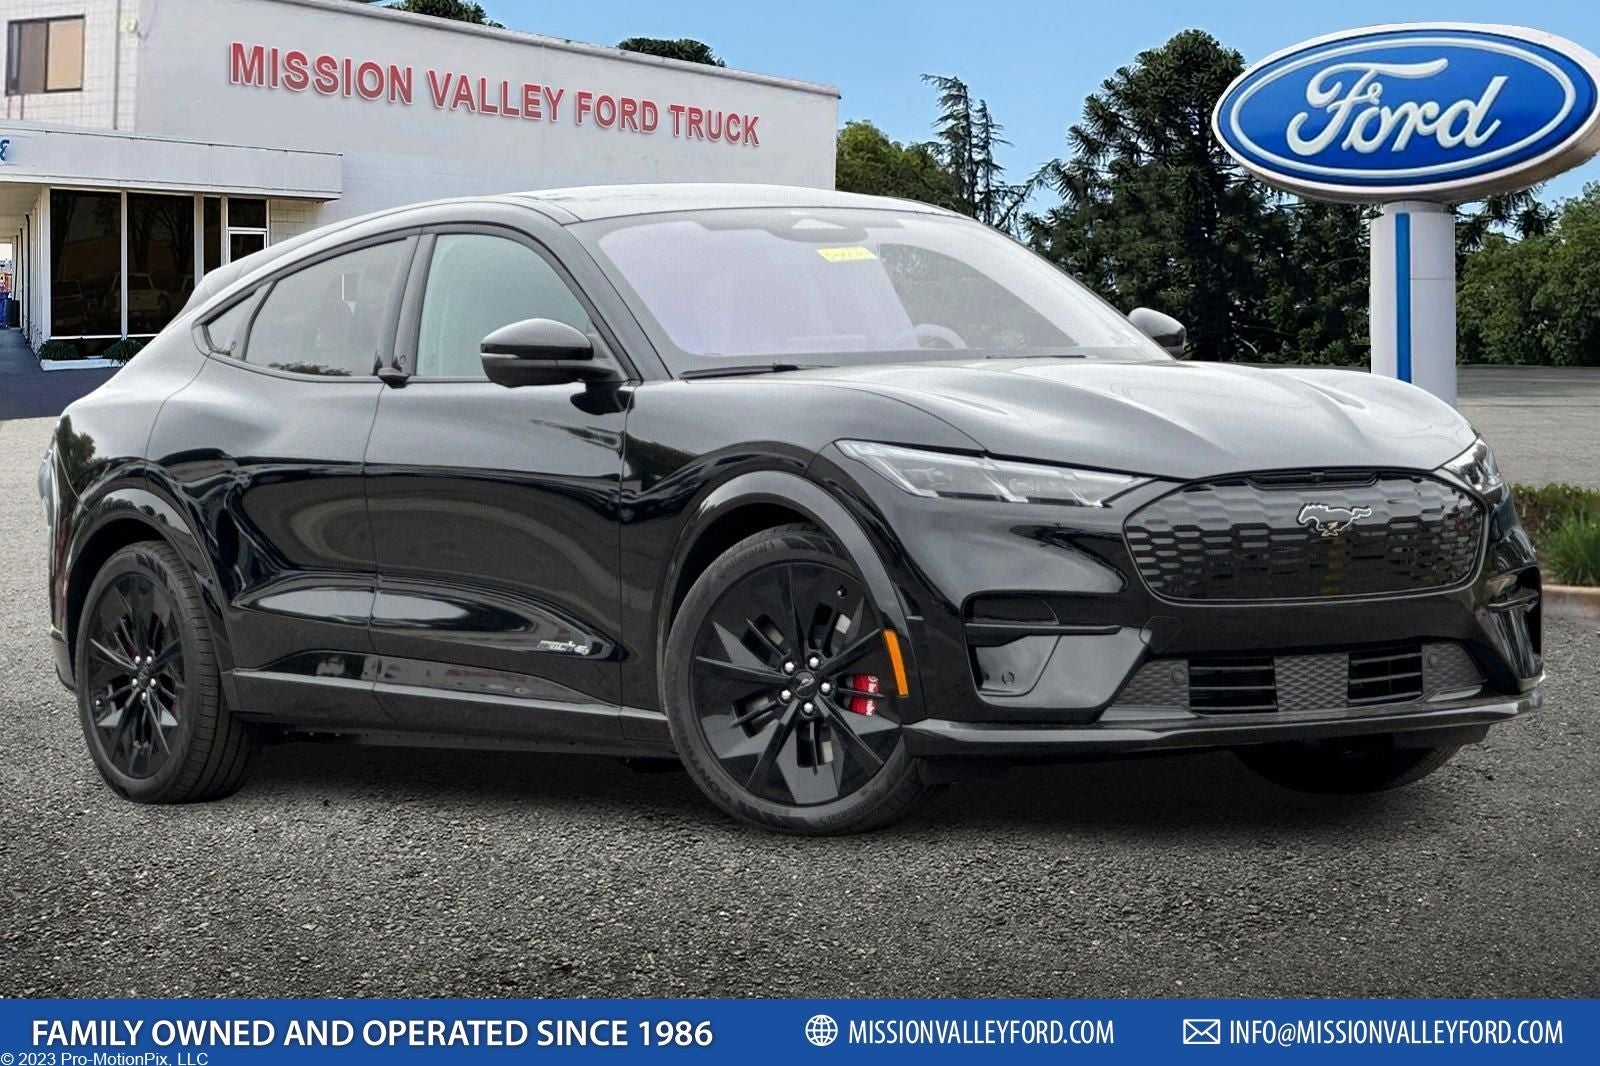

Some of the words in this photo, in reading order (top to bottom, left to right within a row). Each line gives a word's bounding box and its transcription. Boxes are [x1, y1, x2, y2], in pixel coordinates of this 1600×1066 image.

[230, 41, 413, 104] MISSION
[427, 69, 565, 122] VALLEY
[575, 90, 659, 134] FORD
[668, 104, 760, 145] TRUCK
[1286, 58, 1509, 156] Ford
